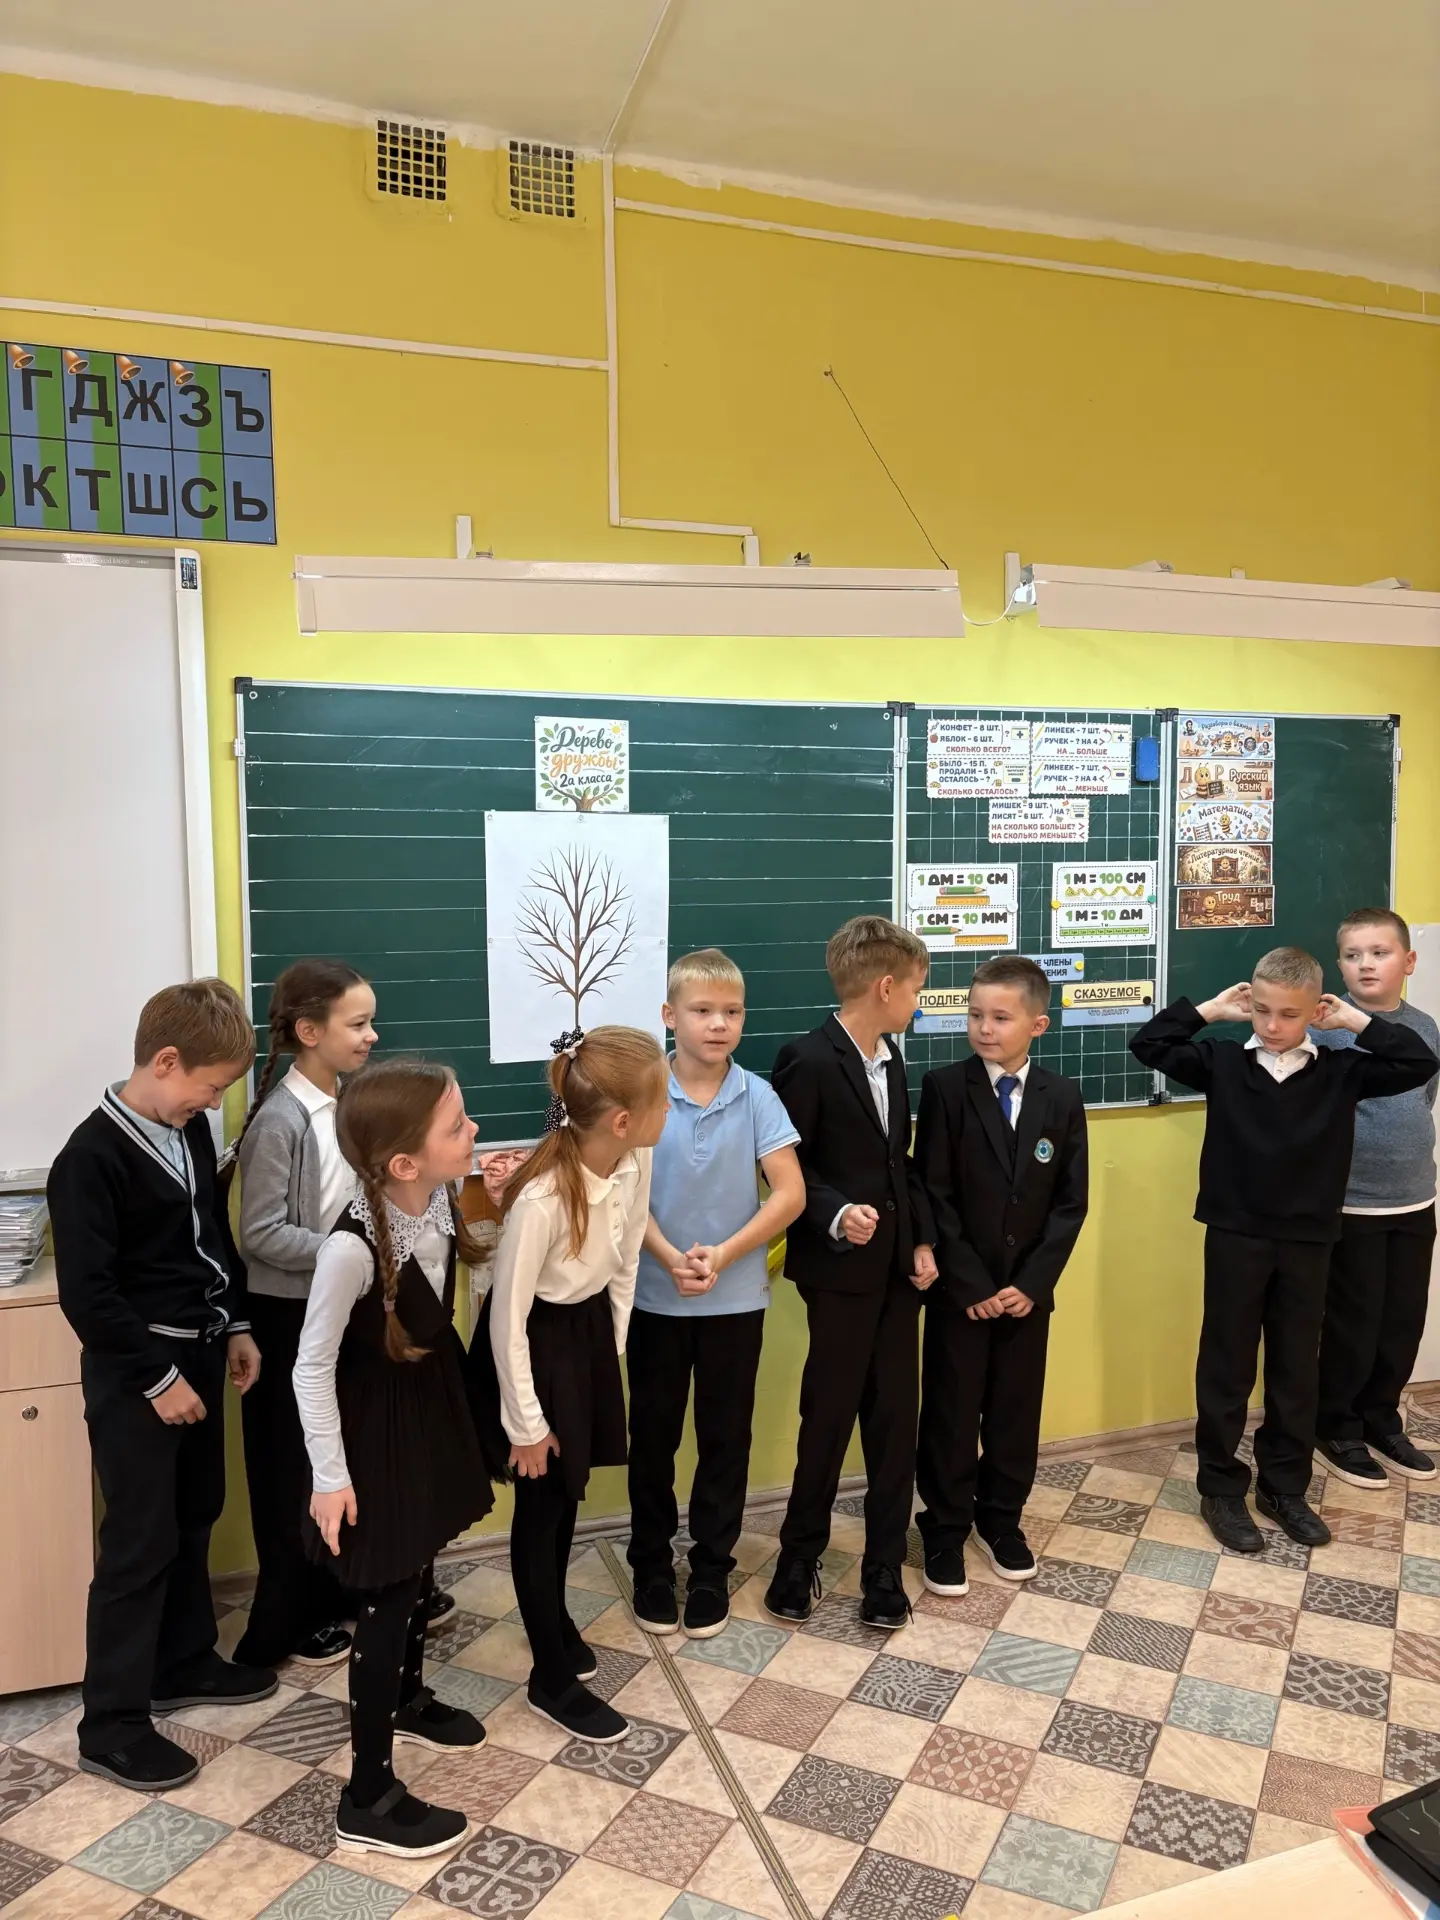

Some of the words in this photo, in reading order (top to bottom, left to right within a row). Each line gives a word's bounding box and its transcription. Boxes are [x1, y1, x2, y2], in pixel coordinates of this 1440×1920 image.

[22, 368, 52, 410] Г
[69, 374, 113, 428] Д
[121, 379, 167, 423] Ж
[179, 385, 212, 427] З
[224, 390, 265, 433] Ъ
[22, 464, 59, 509] К
[75, 468, 111, 511] Т
[127, 472, 169, 516] Ш
[181, 478, 218, 519] С
[233, 481, 268, 522] Ь
[550, 726, 614, 754] Дерево
[550, 750, 618, 777] дружбы
[560, 774, 575, 788] 2а
[578, 774, 612, 785] класса
[1230, 769, 1268, 783] Русский
[1239, 783, 1261, 792] язык
[1198, 805, 1253, 820] Математика
[917, 874, 924, 886] 1
[928, 874, 953, 885] ДМ
[967, 873, 983, 885] 10
[987, 873, 1008, 884] СМ
[1064, 873, 1071, 885] 1
[1073, 873, 1086, 884] М
[1099, 873, 1123, 884] 100
[1126, 872, 1146, 883] СМ
[1215, 891, 1241, 904] Труд
[916, 913, 924, 925] 1
[927, 913, 948, 925] СМ
[962, 913, 978, 924] 10
[982, 912, 1007, 924] ММ
[1065, 910, 1073, 922] 1
[1076, 910, 1088, 921] М
[1101, 910, 1116, 920] 10
[1119, 909, 1142, 920] ДМ
[1074, 987, 1141, 999] СКАЗУЕМОЕ
[920, 994, 970, 1007] ПОДЛЕЖ
